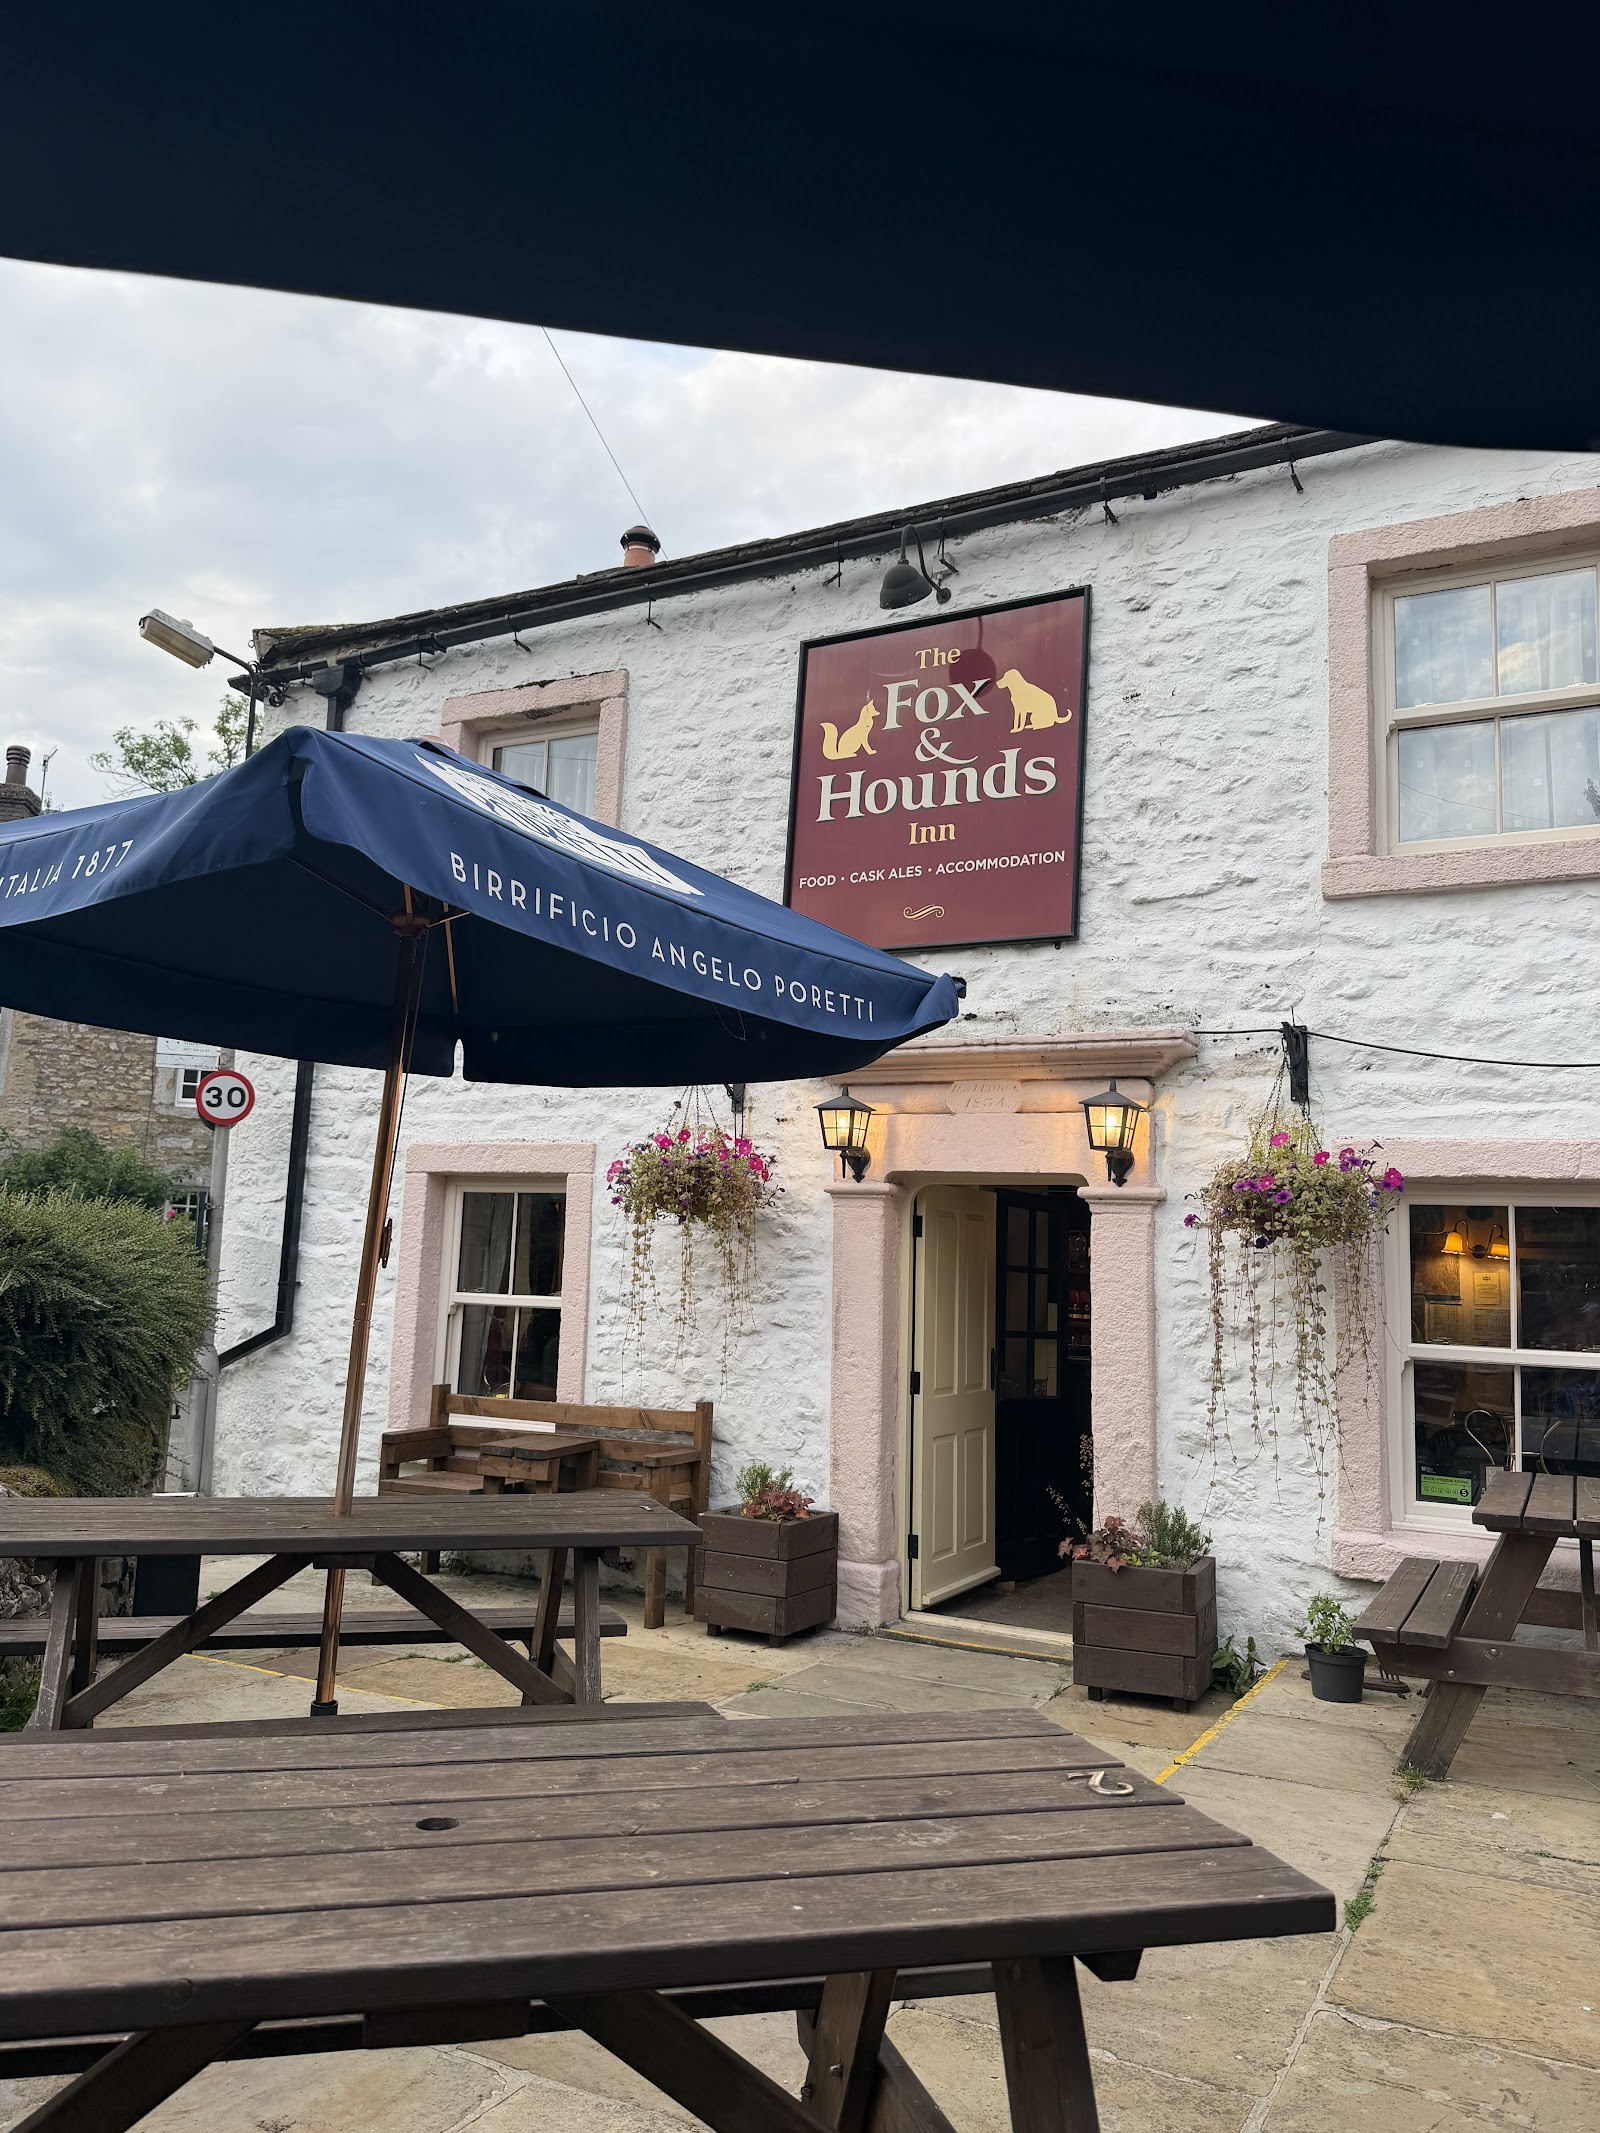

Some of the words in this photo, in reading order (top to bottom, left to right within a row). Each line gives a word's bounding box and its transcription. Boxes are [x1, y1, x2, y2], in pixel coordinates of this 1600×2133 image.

[915, 647, 961, 670] The
[882, 677, 991, 731] Fox
[915, 727, 978, 764] &
[815, 747, 1057, 822] Hounds
[908, 822, 956, 845] Inn
[72, 839, 134, 879] 1877
[799, 874, 836, 889] FOOD
[849, 868, 885, 883] CASK
[888, 865, 922, 880] ALES
[935, 850, 1066, 875] ACCOMMODATION
[450, 851, 637, 949] BIRRIFICIO
[651, 936, 762, 991] ANGELO
[774, 974, 874, 1023] PORETTI
[205, 1086, 246, 1108] 30
